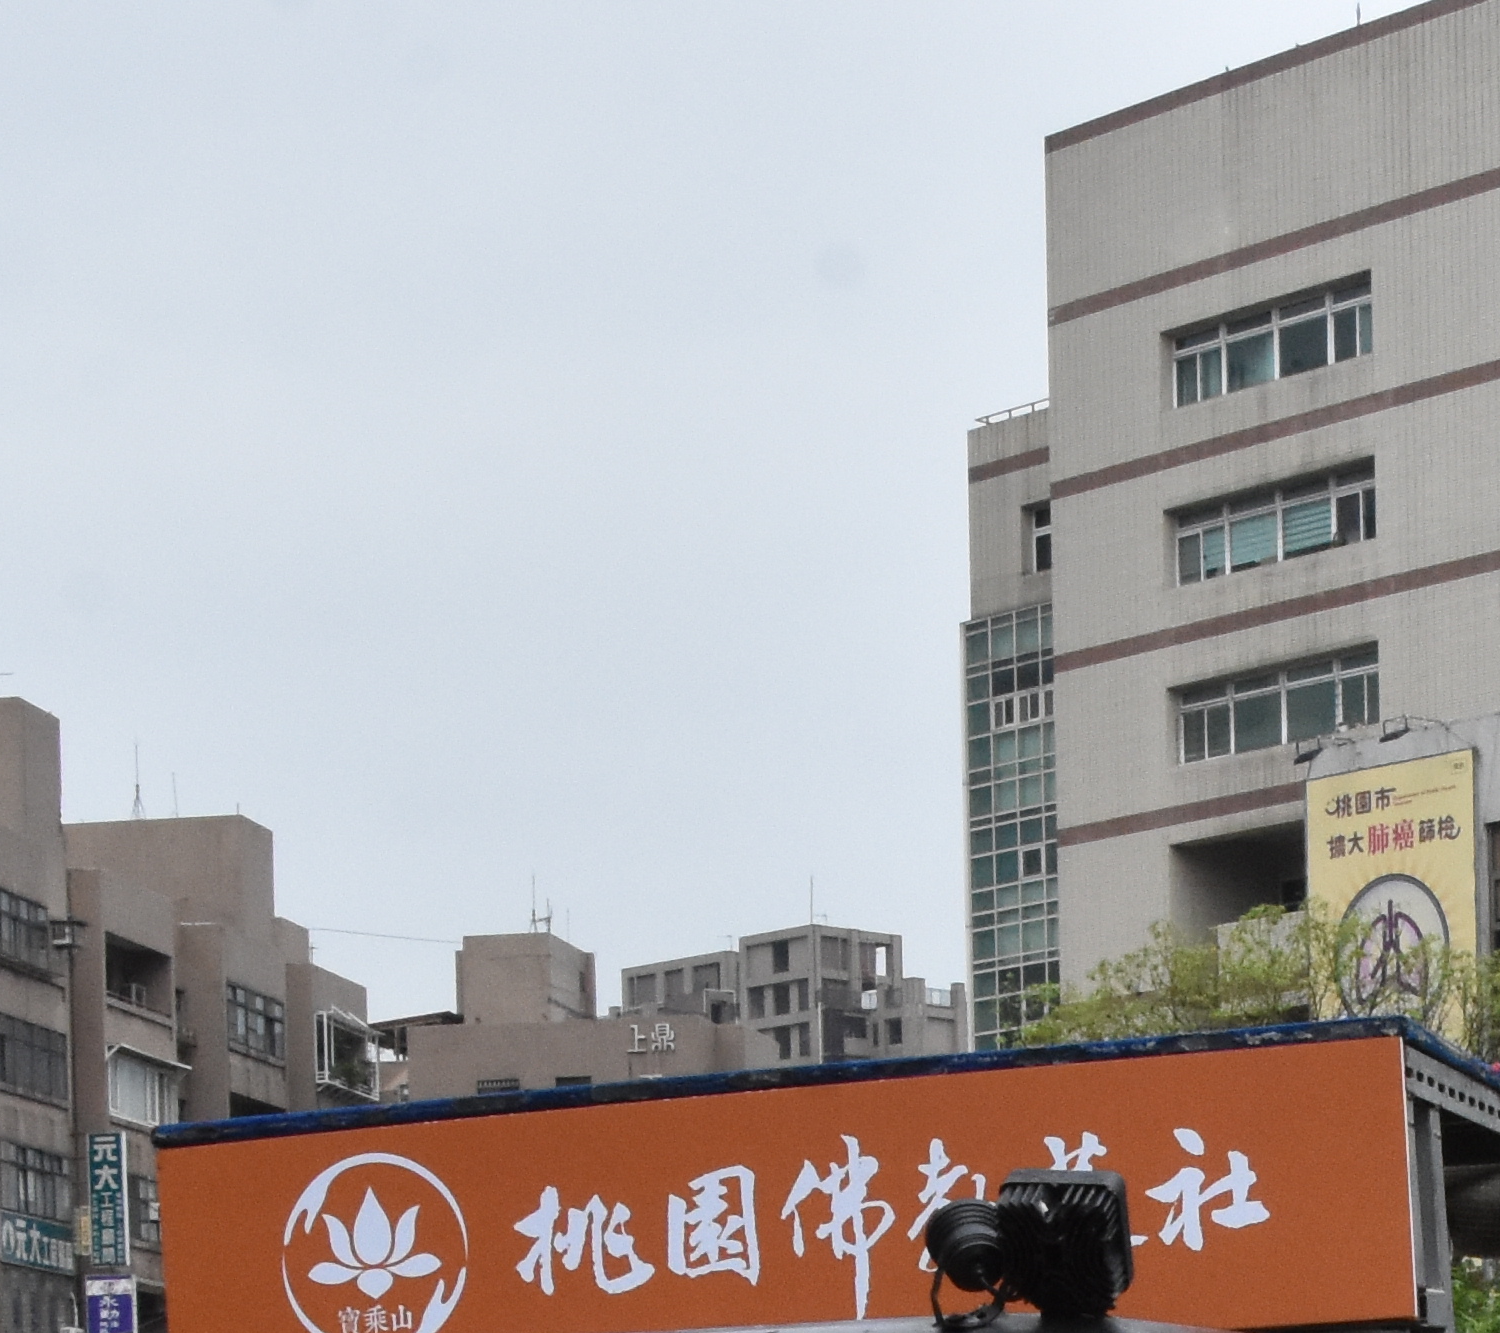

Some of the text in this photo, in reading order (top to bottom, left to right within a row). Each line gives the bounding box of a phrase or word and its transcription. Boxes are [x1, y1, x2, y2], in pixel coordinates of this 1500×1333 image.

[1326, 787, 1397, 818] 桃園市
[1327, 815, 1461, 860] 擴大肺癌篩檢
[626, 1023, 675, 1053] 上鼎
[512, 1128, 1270, 1320] 桃園佛社
